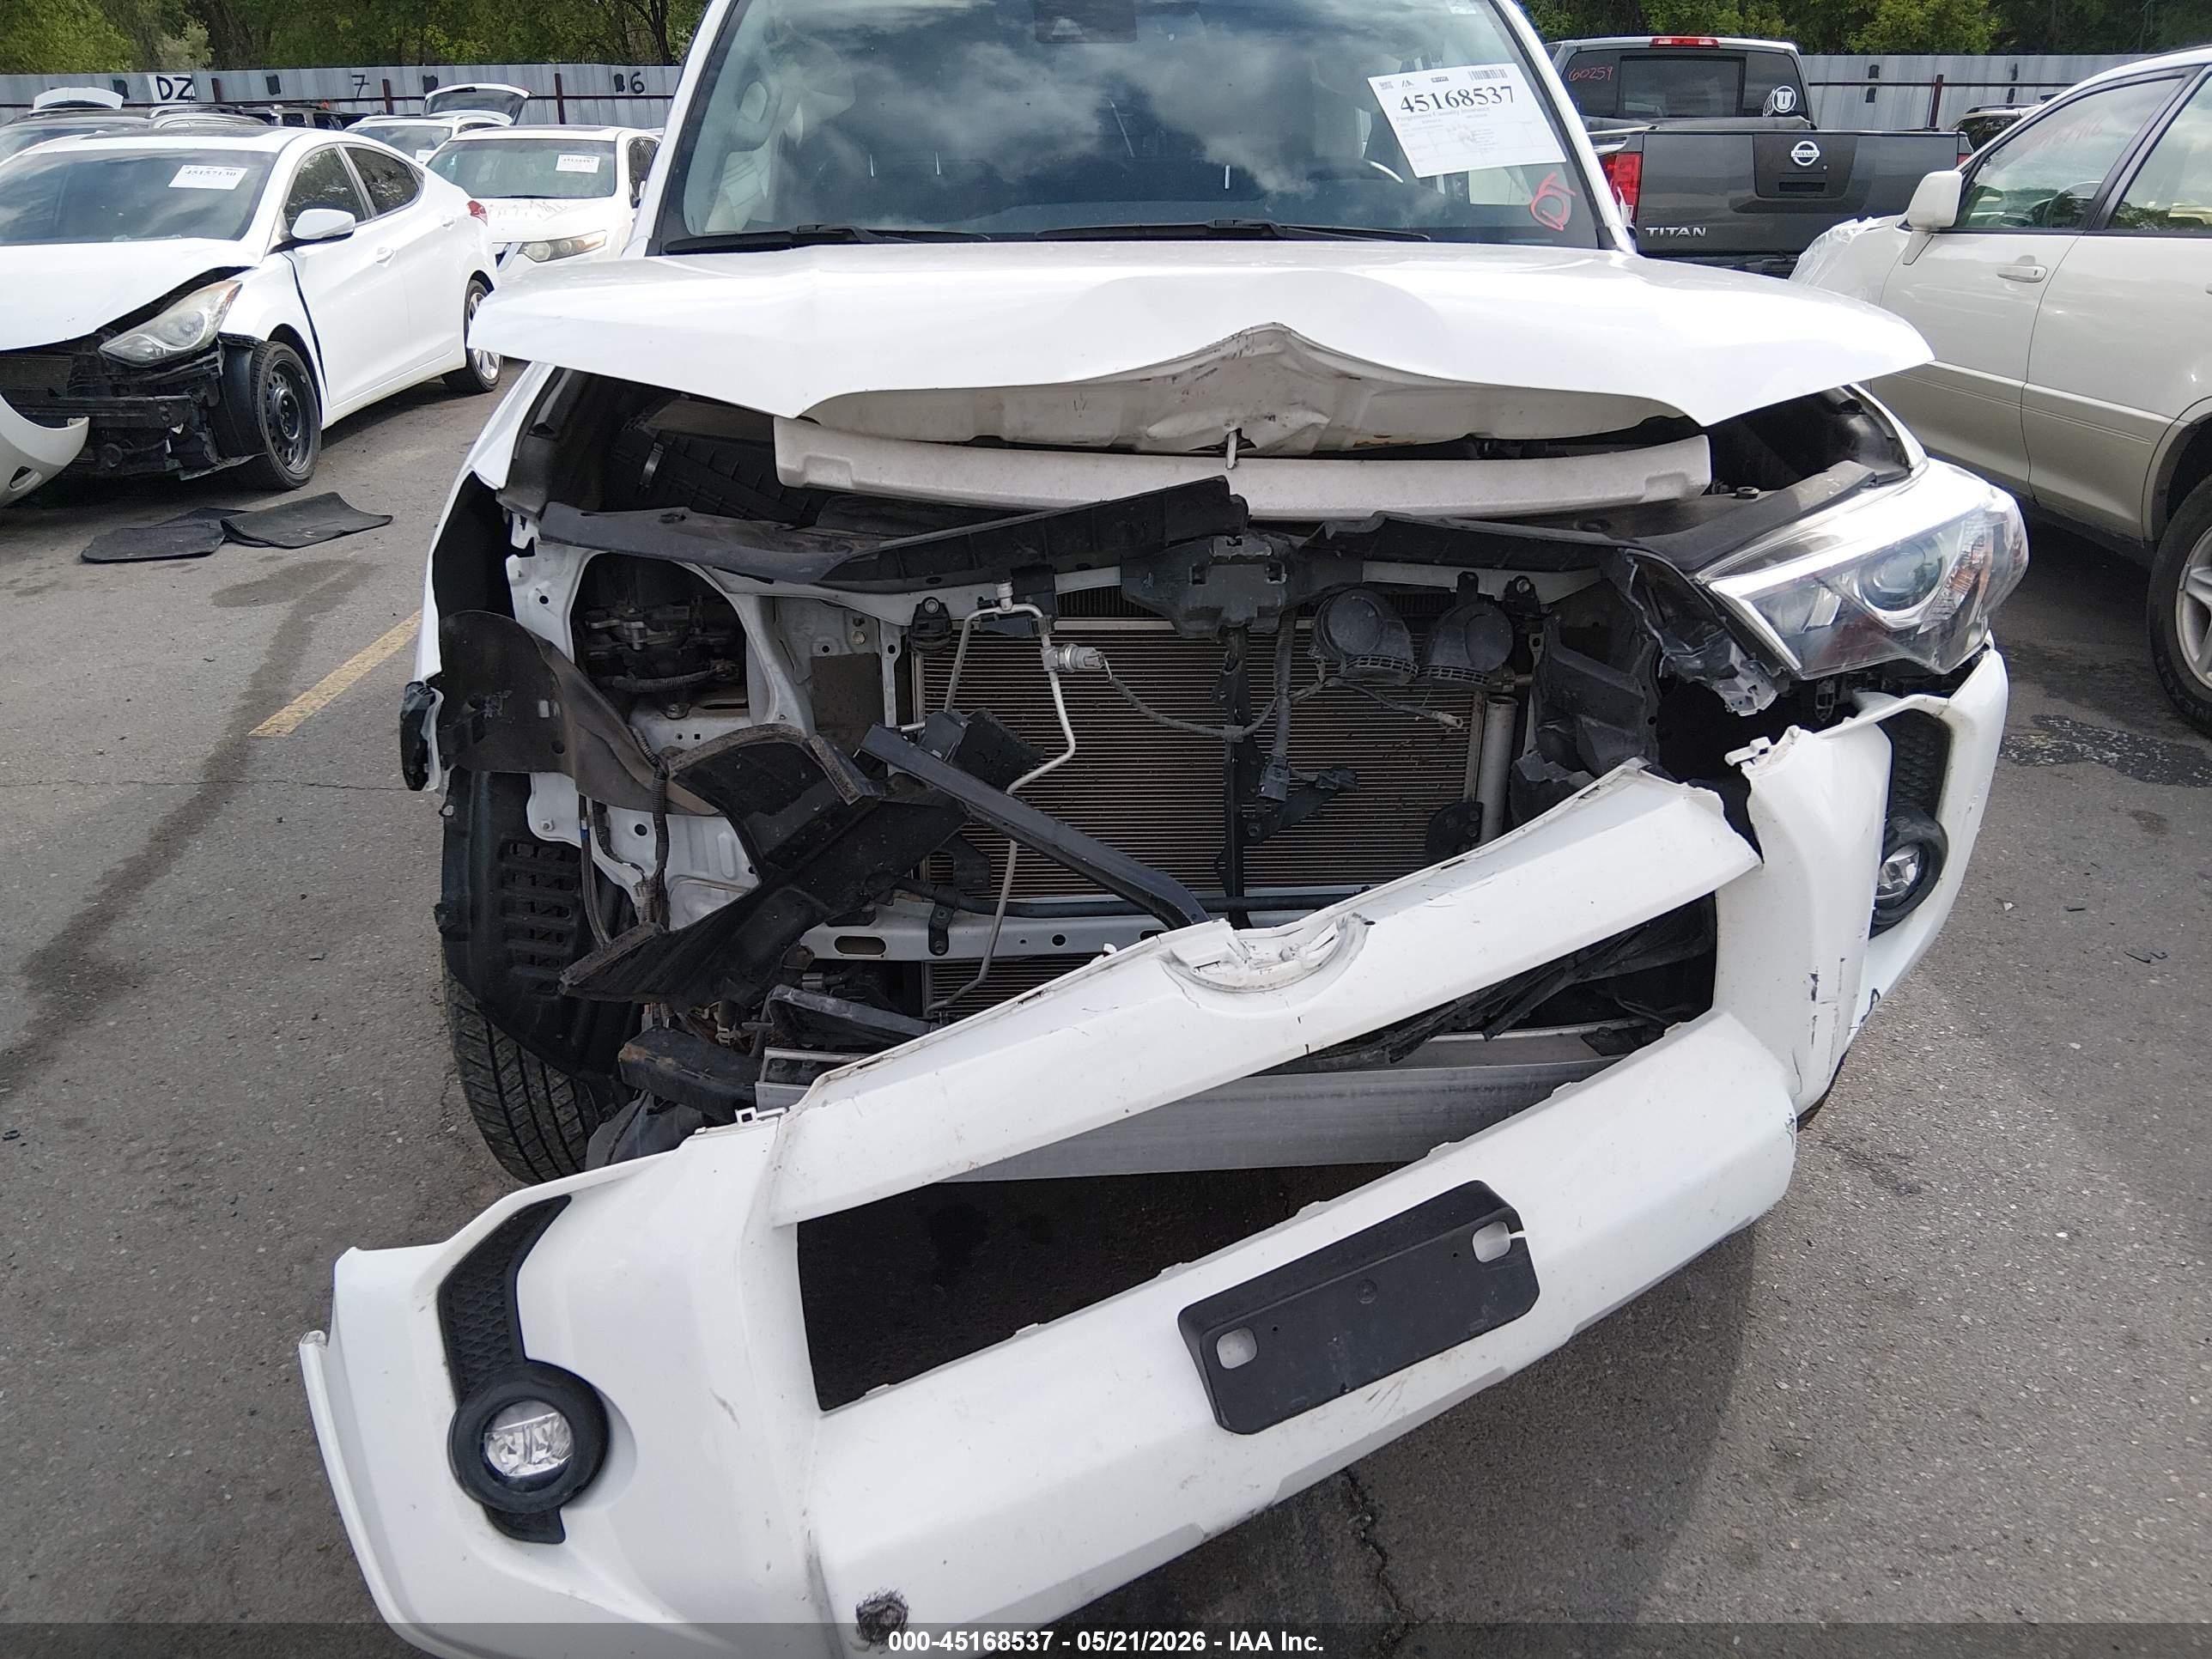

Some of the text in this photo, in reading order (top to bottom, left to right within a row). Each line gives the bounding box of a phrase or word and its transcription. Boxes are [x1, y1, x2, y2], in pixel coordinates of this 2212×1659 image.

[1569, 66, 1613, 82] 60259
[351, 74, 370, 98] 7
[1401, 85, 1515, 113] 45168537
[1645, 227, 1706, 237] TITAN
